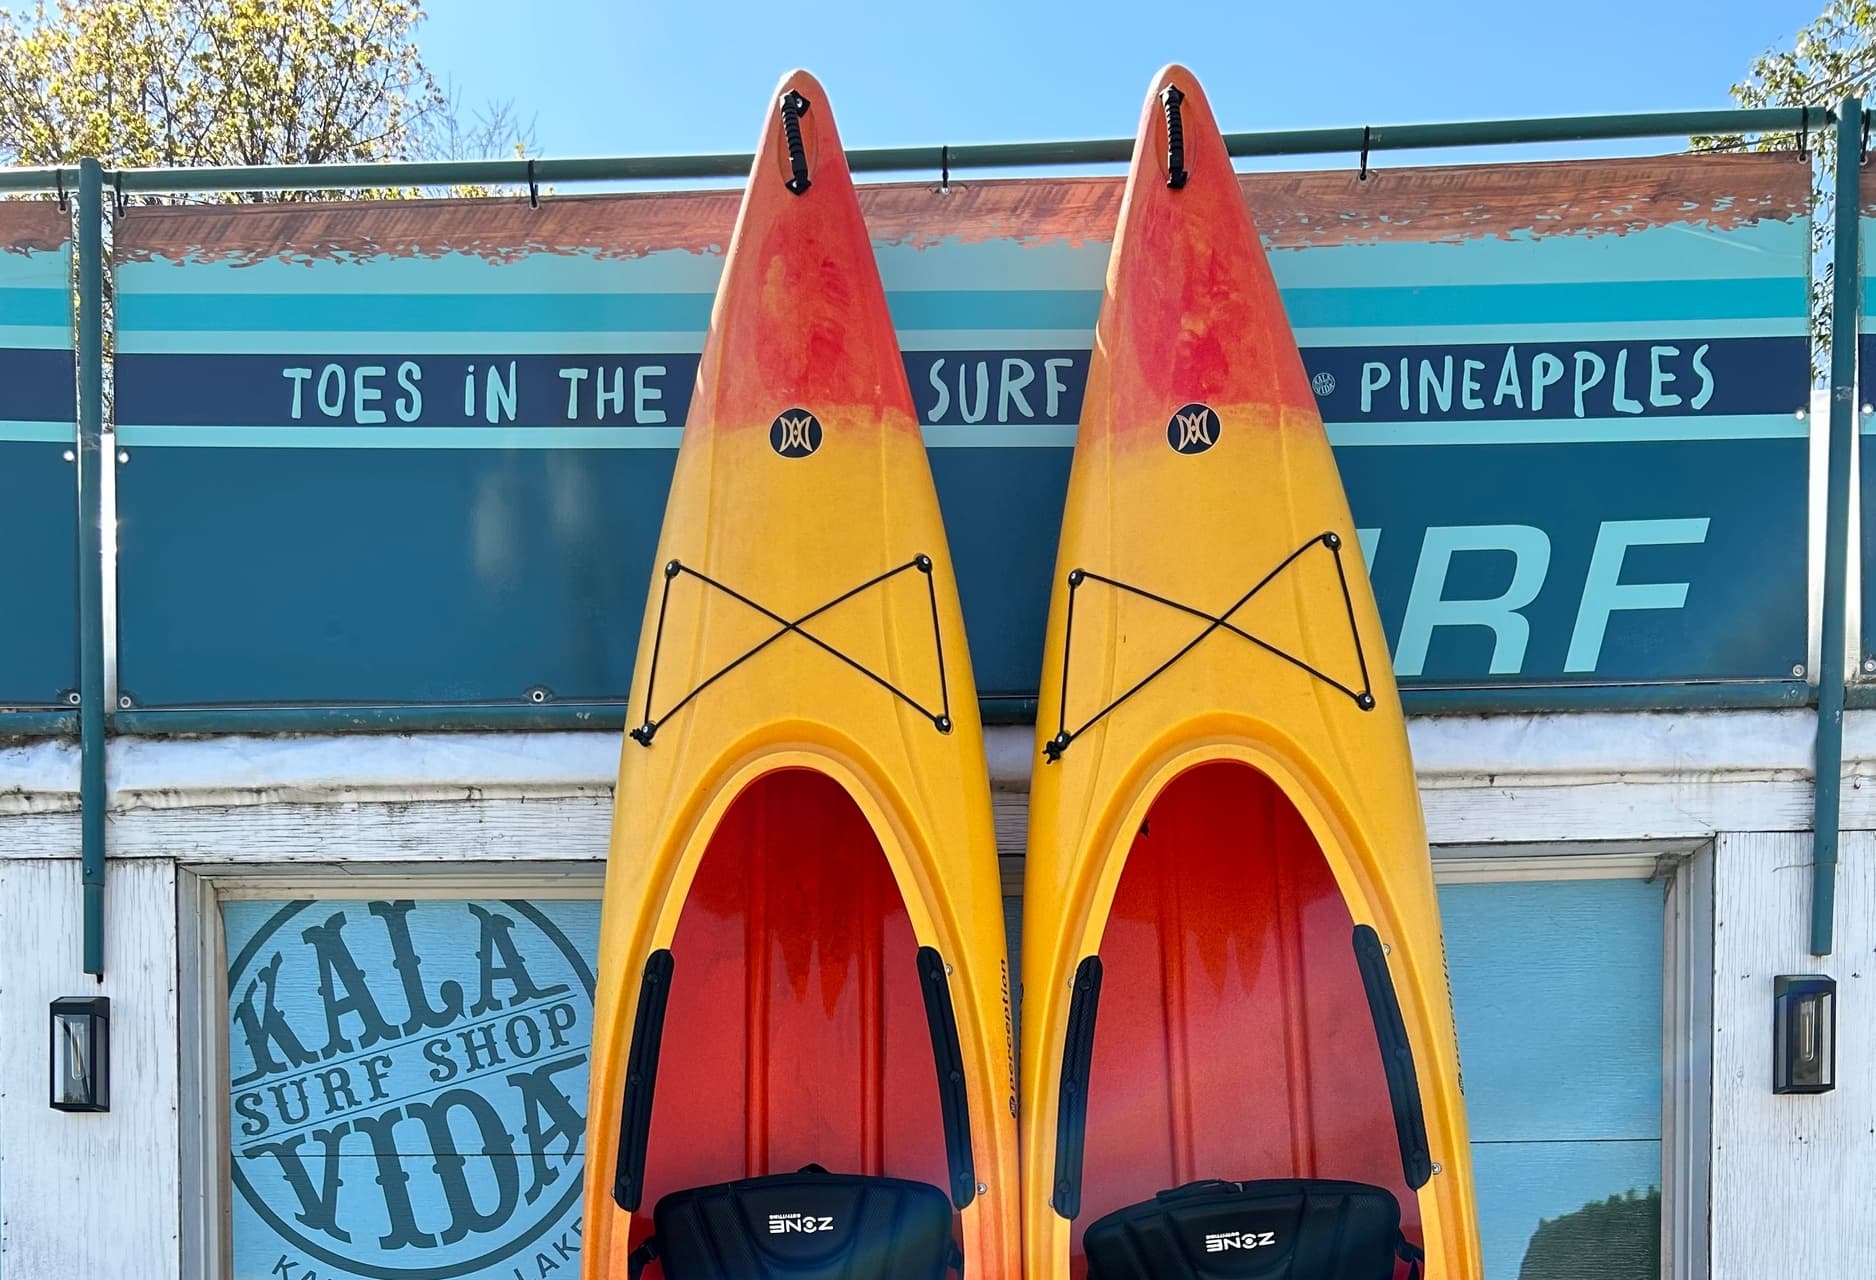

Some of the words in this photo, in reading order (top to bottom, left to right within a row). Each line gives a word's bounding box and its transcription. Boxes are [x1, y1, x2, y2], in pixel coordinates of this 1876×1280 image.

[283, 360, 423, 424] TOES
[558, 365, 668, 424] THE
[928, 358, 1074, 424] SURF
[1360, 344, 1715, 418] PINEAPPLES
[1355, 517, 1711, 677] RF
[232, 900, 571, 1087] KALA
[1000, 958, 1016, 1092] perception
[235, 1054, 393, 1136] SURF
[422, 1002, 577, 1082] SHOP
[242, 1054, 587, 1250] VIDA
[769, 1216, 833, 1234] ZONE
[1205, 1231, 1275, 1252] ZONE
